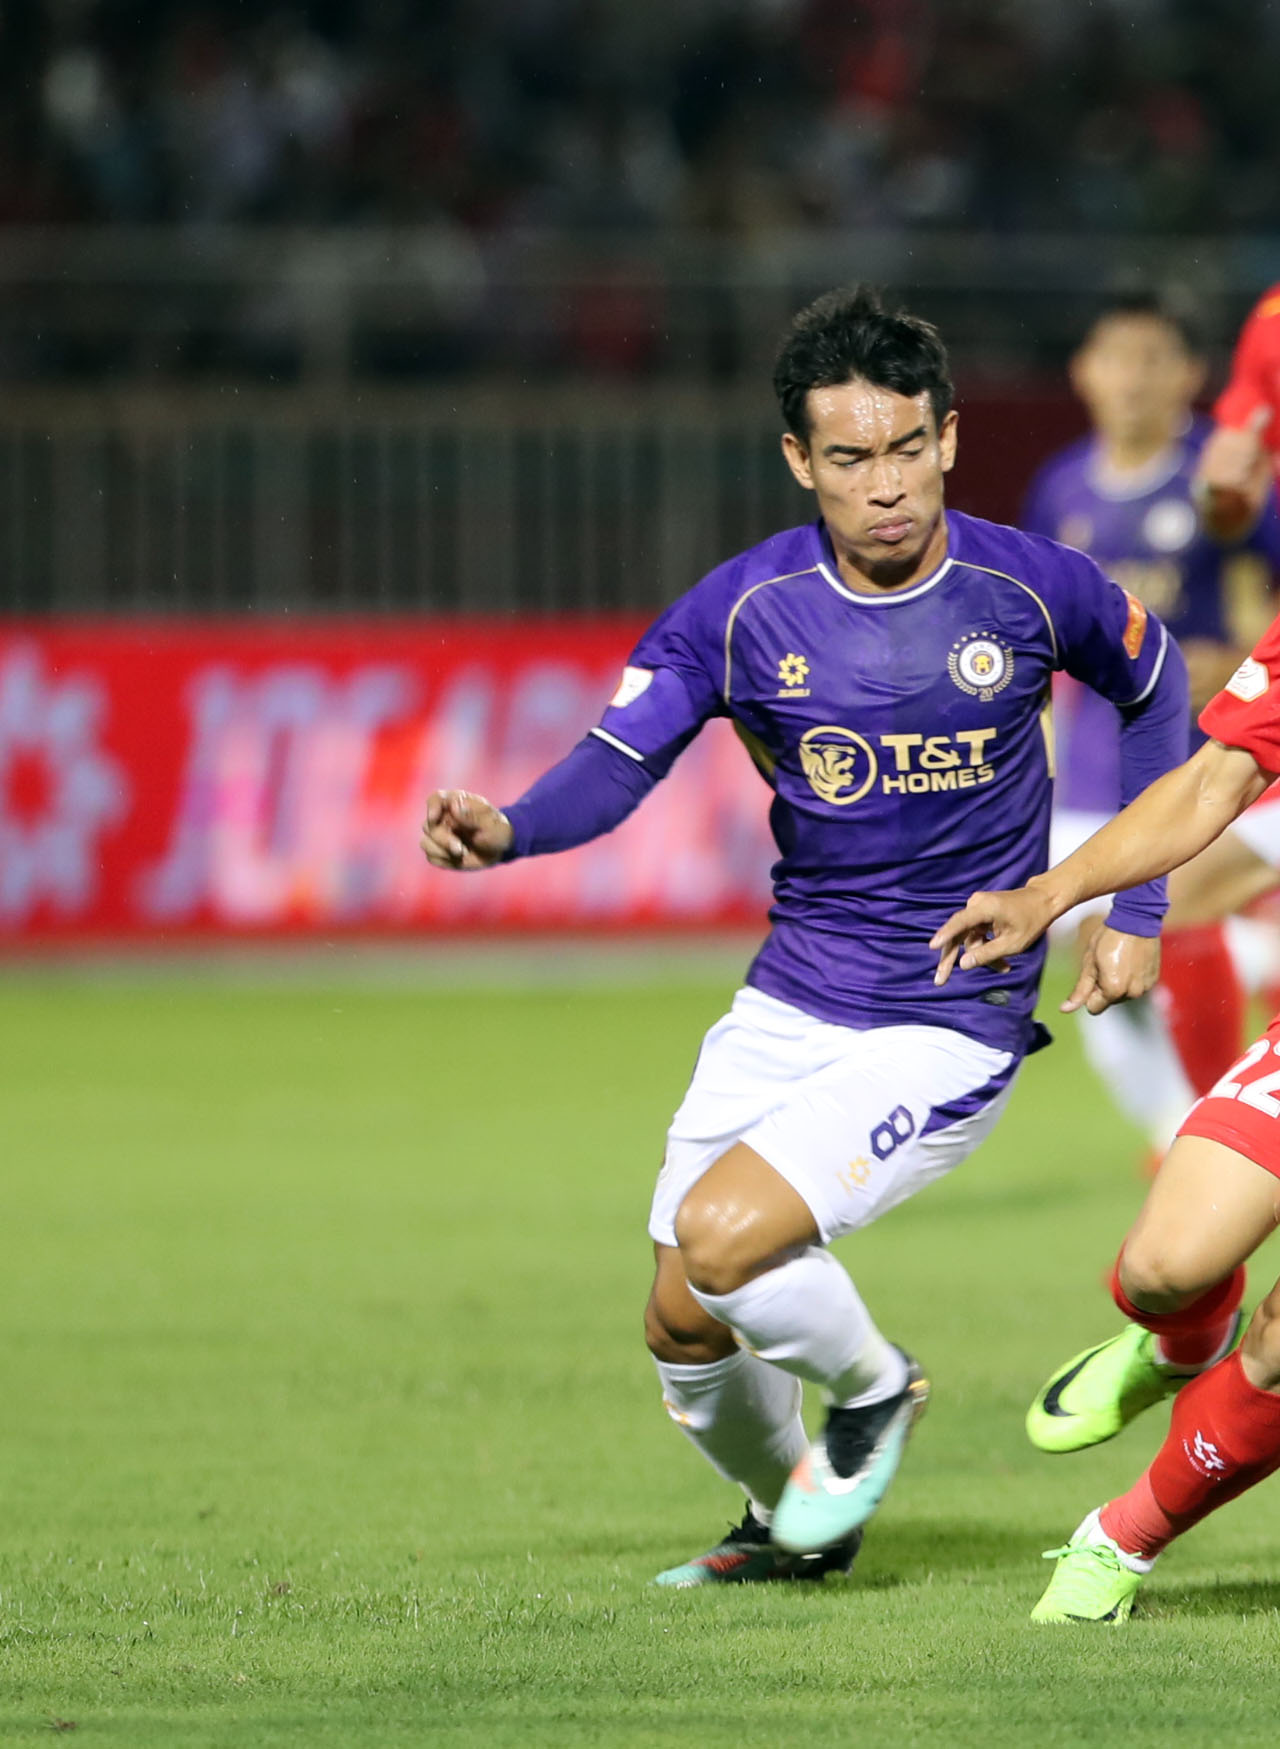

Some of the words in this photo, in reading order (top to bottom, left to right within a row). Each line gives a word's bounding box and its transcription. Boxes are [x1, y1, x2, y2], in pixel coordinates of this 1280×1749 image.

[880, 728, 997, 771] T&T
[882, 763, 996, 795] HOMES
[870, 1104, 915, 1162] 8
